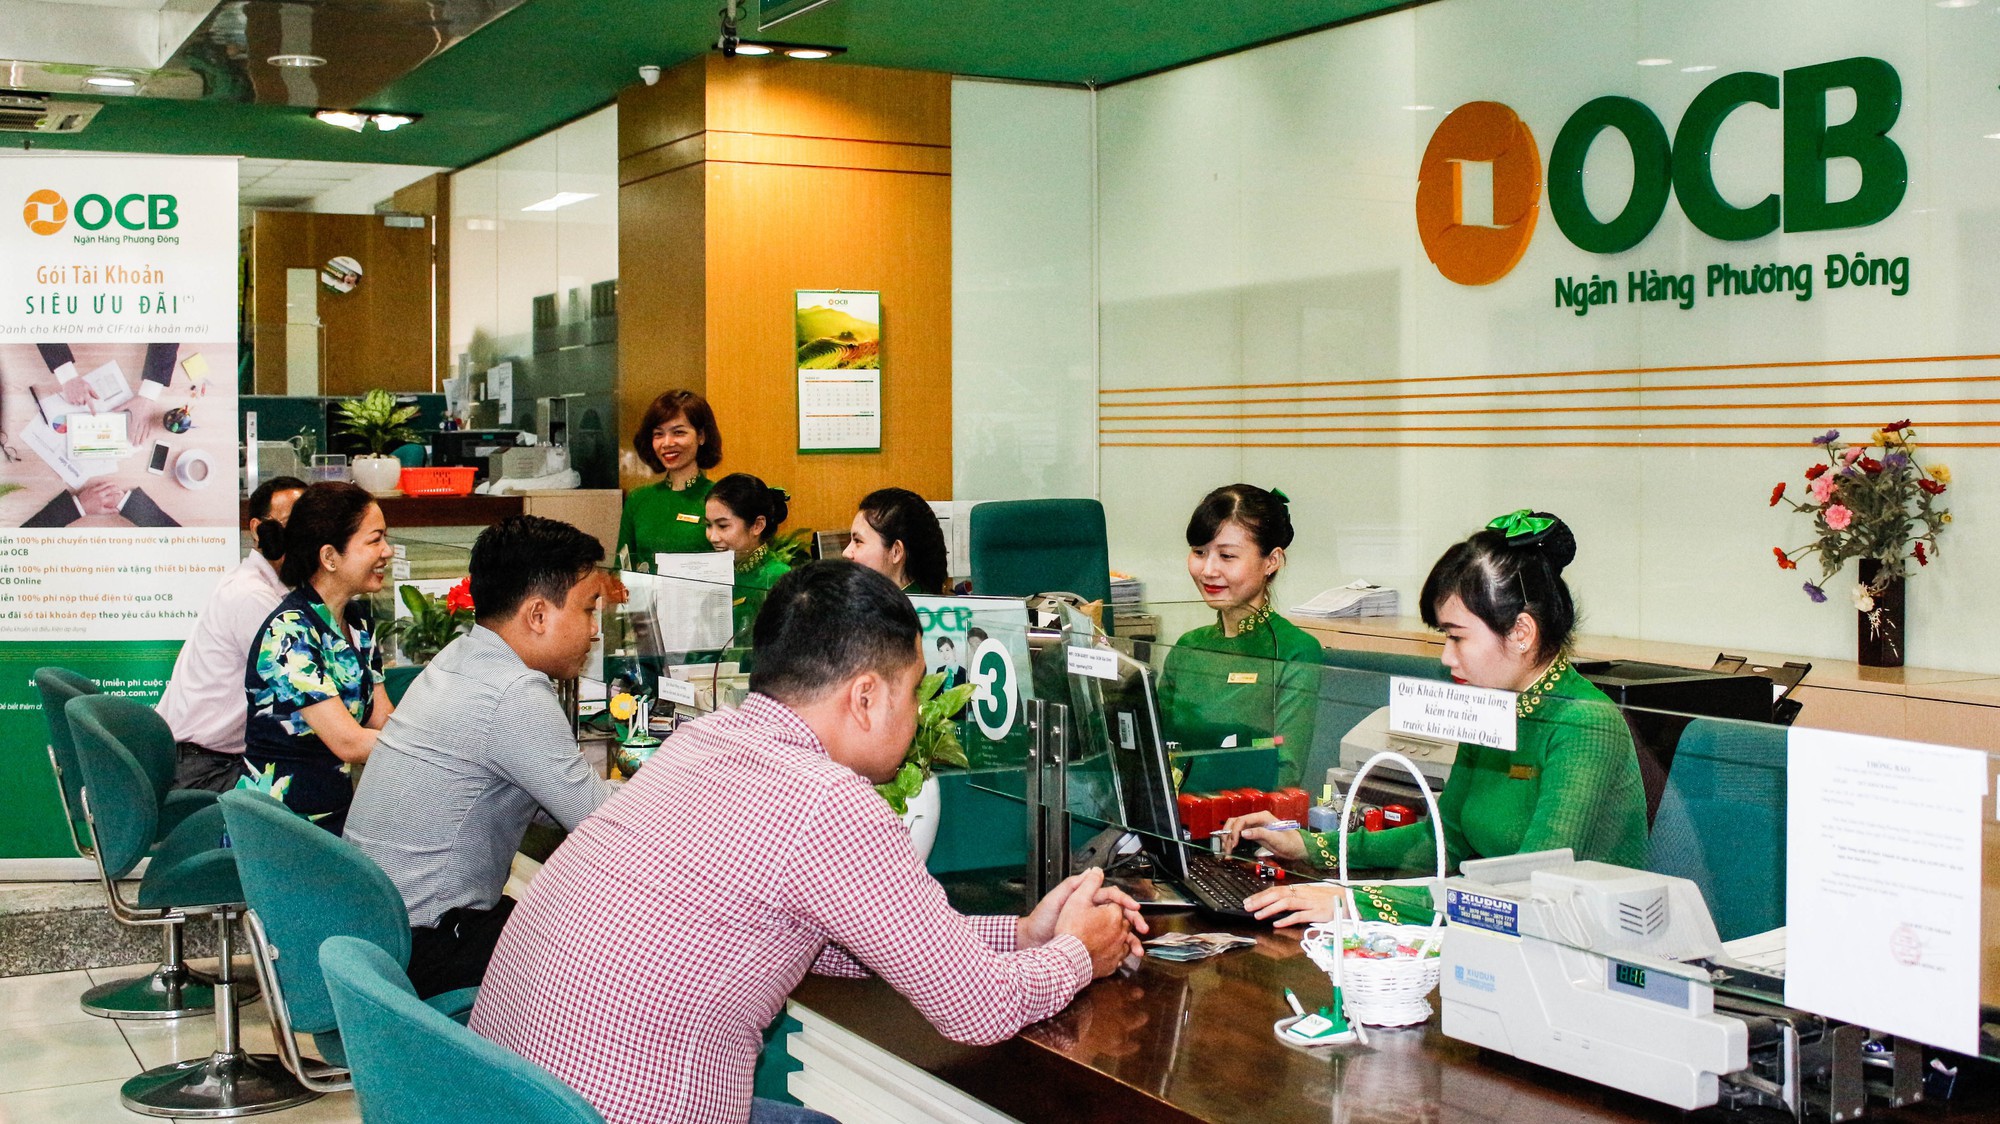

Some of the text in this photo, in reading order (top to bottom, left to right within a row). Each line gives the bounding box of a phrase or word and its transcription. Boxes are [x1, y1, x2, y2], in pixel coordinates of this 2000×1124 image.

[1547, 55, 1908, 255] OCB
[73, 193, 179, 231] OCB
[73, 234, 180, 246] Ngân Hàng Phương Đông
[36, 263, 164, 284] Gói Tài Khoản
[1555, 250, 1909, 316] Ngân Hàng Phương Đông
[25, 292, 78, 314] SIÊU
[93, 293, 123, 314] ƯU
[138, 291, 177, 314] ĐÃI
[30, 324, 49, 334] cho
[52, 324, 84, 334] KHDN
[87, 324, 103, 334] mở
[148, 324, 181, 334] khoản
[41, 536, 55, 546] phí
[109, 536, 133, 546] trong
[135, 536, 157, 544] nước
[159, 536, 169, 544] và
[171, 536, 185, 545] phí
[201, 536, 226, 545] lương
[11, 548, 29, 556] OCB
[43, 565, 58, 575] phí
[60, 565, 93, 575] thường
[95, 565, 115, 573] niên
[117, 565, 128, 573] và
[130, 565, 152, 575] tặng
[154, 564, 176, 572] thiết
[178, 564, 187, 574] bị
[189, 564, 206, 572] bảo
[13, 577, 42, 585] Online
[0, 593, 14, 601] iễn
[17, 594, 40, 602] 100%
[43, 594, 57, 603] phí
[79, 593, 99, 602] thuế
[134, 595, 152, 603] qua
[8, 611, 21, 619] đãi
[35, 611, 47, 619] tài
[49, 611, 78, 619] khoản
[99, 611, 119, 619] theo
[121, 611, 138, 620] yêu
[158, 610, 185, 618] khách
[102, 678, 126, 688] (miễn
[127, 679, 141, 688] phí
[142, 680, 163, 688] cuộc
[978, 651, 1008, 729] 3
[1398, 682, 1508, 710] Quý Khách Hàng vui lòng
[1424, 702, 1478, 722] kiểm tra tiền
[1402, 719, 1502, 748] trước khi rời khỏi Quầy
[1461, 893, 1513, 911] XIUDUN
